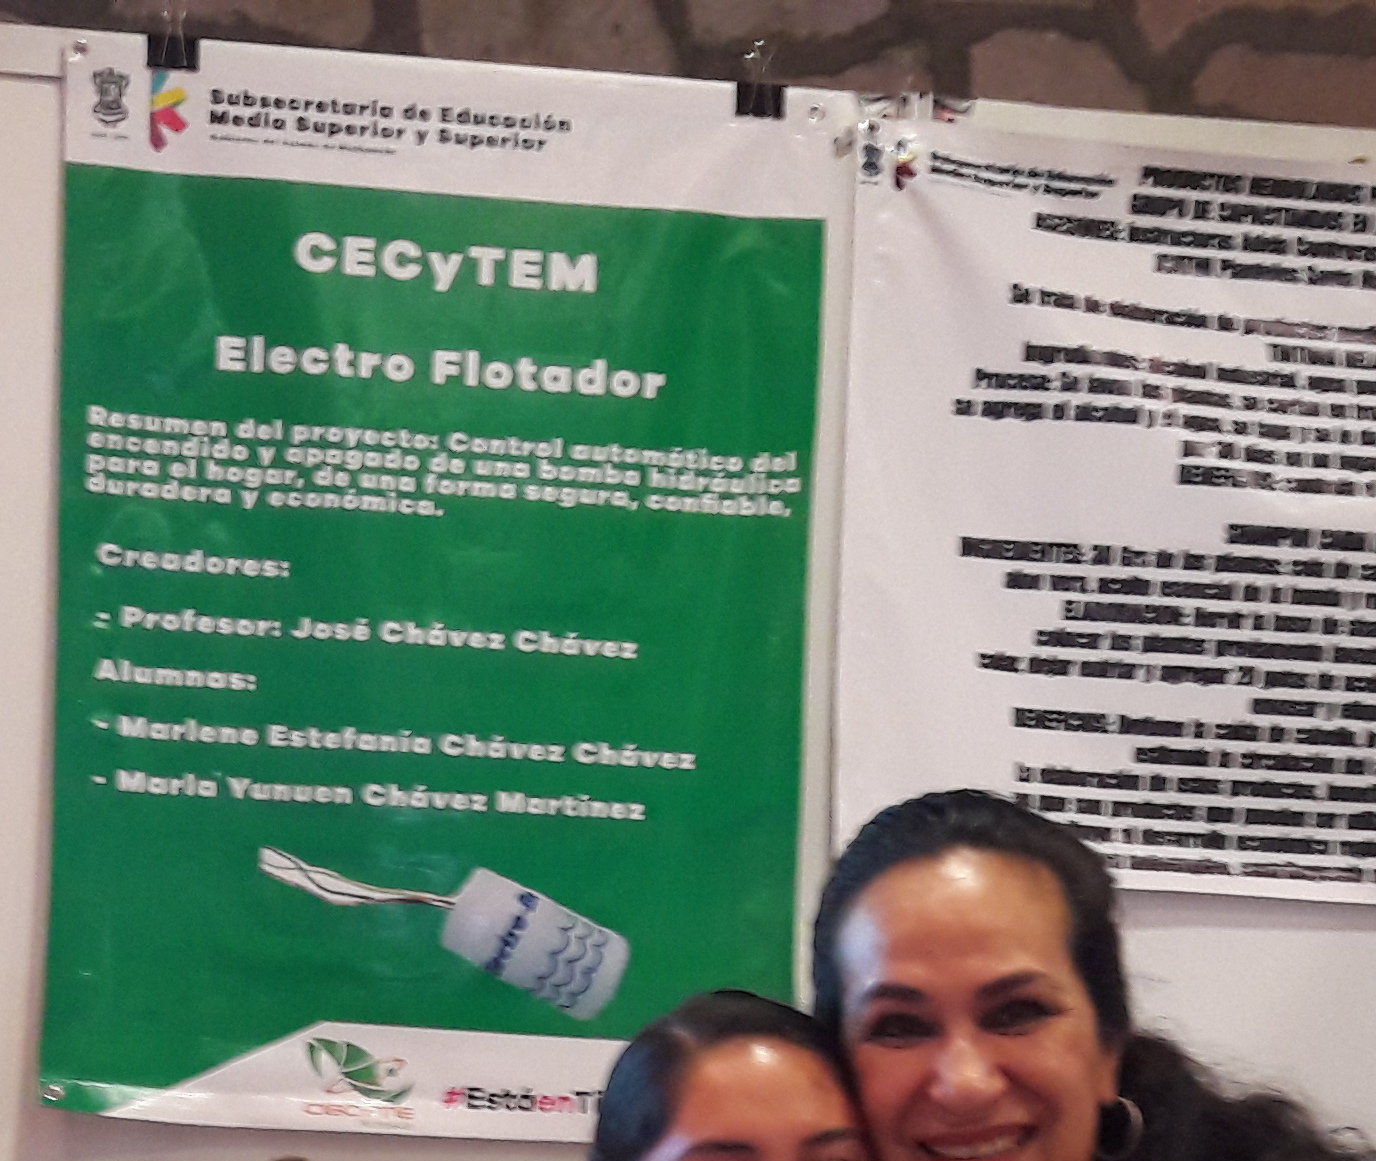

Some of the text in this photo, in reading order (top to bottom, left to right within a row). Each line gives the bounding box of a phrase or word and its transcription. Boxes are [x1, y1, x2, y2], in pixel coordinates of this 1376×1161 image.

[209, 88, 572, 132] Subsecretaría de Educación
[209, 109, 286, 131] Media
[295, 114, 407, 141] Superior
[414, 124, 430, 146] y
[437, 121, 547, 151] Superior
[294, 231, 599, 293] CECyTEM
[215, 334, 667, 399] Electro Flotador
[86, 403, 798, 474] Resumen del proyecto: Control automático del
[86, 431, 802, 494] encendido y apagado de una bomba hidráulica
[84, 472, 445, 517] duradera y económica.
[85, 453, 792, 517] para el hogar, de una forma segura, confiable,
[95, 542, 291, 578] Creadores:
[118, 604, 283, 638] Profesor:
[291, 617, 371, 642] José
[378, 619, 506, 650] Chávez
[513, 629, 639, 660] Chávez
[93, 657, 258, 691] Alumnas:
[117, 714, 260, 746] Marlene
[267, 724, 433, 755] Estefanía
[438, 733, 566, 763] Chávez
[571, 741, 697, 770] Chávez
[226, 775, 354, 805] Yunuen
[361, 783, 489, 813] Chávez
[494, 789, 646, 821] Martínez
